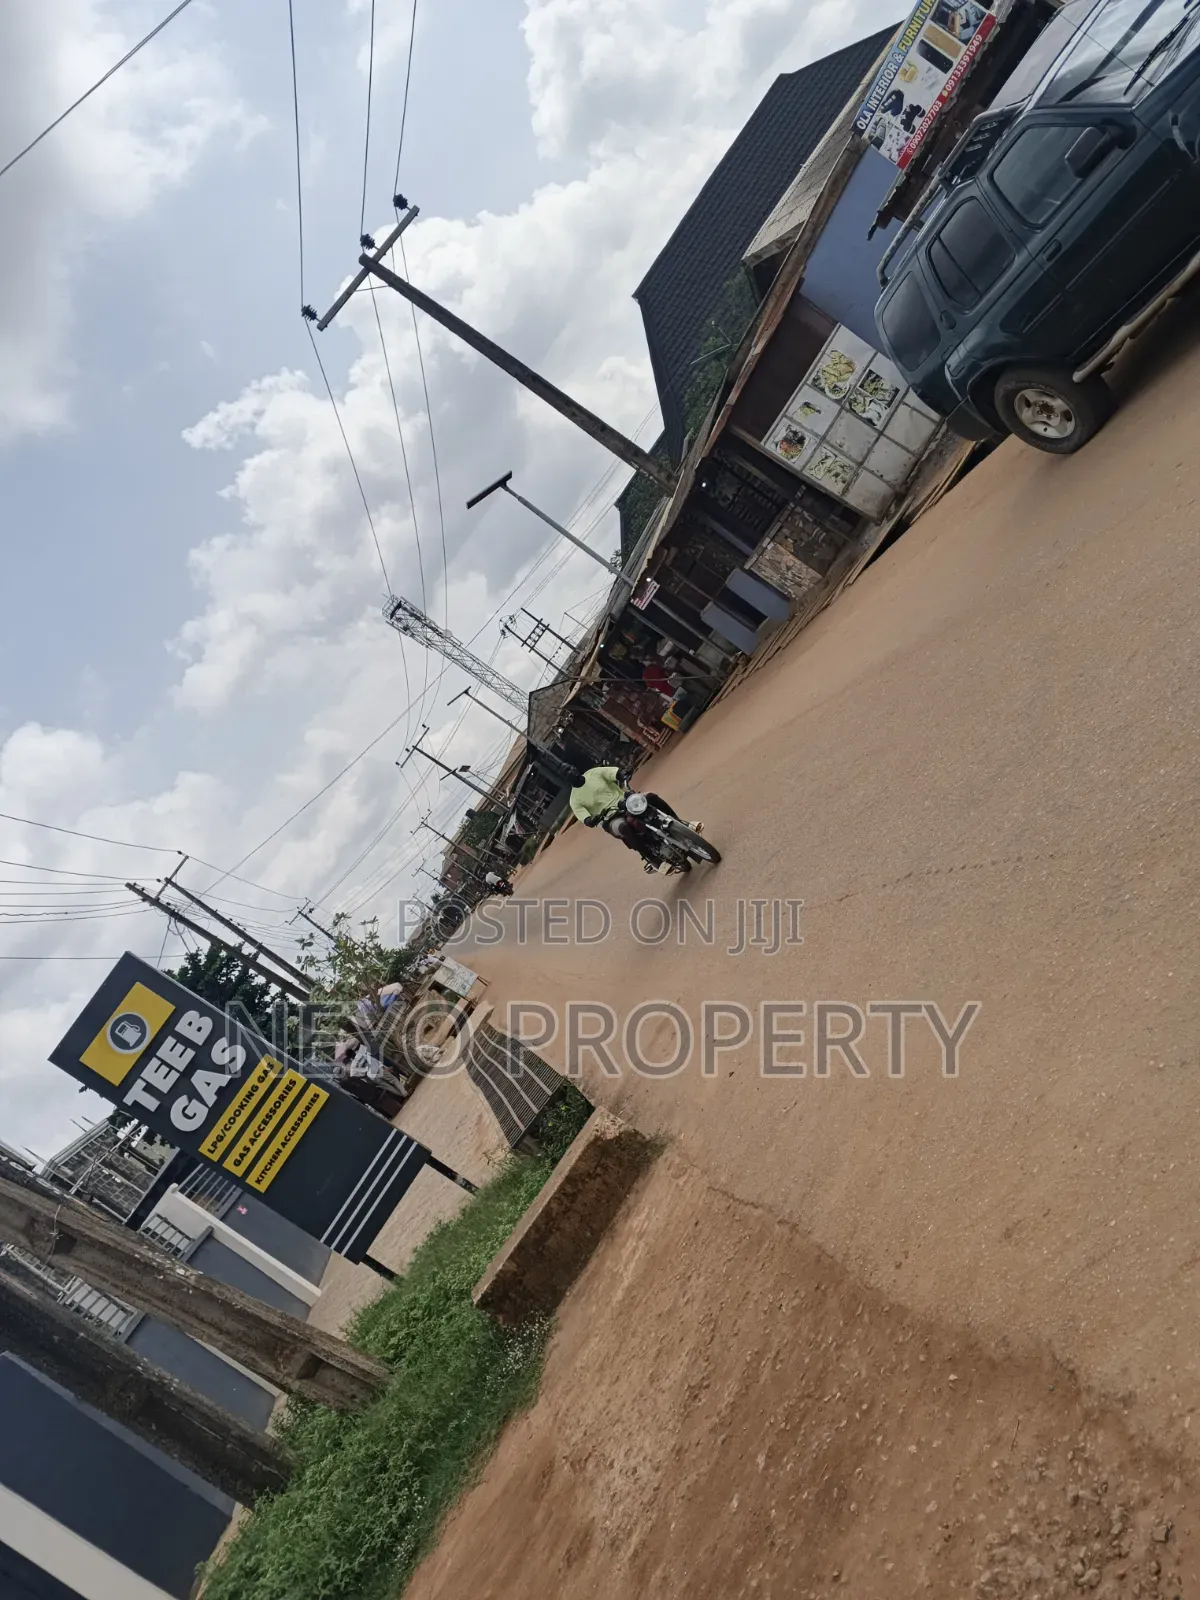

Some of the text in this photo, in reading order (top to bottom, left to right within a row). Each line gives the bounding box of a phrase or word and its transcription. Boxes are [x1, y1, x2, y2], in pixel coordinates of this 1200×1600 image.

[856, 110, 873, 130] OLA
[866, 61, 899, 111] INTERIOR
[893, 53, 904, 63] &
[910, 34, 982, 149] 09072027703 09133391949
[123, 1009, 214, 1113] TEEB
[170, 1037, 246, 1132] GAS
[207, 1062, 275, 1154] LPG/COOKING GAS
[233, 1079, 297, 1168] GAS ACCESSORIES
[254, 1092, 320, 1185] KITCHEN ACCESSORIES
